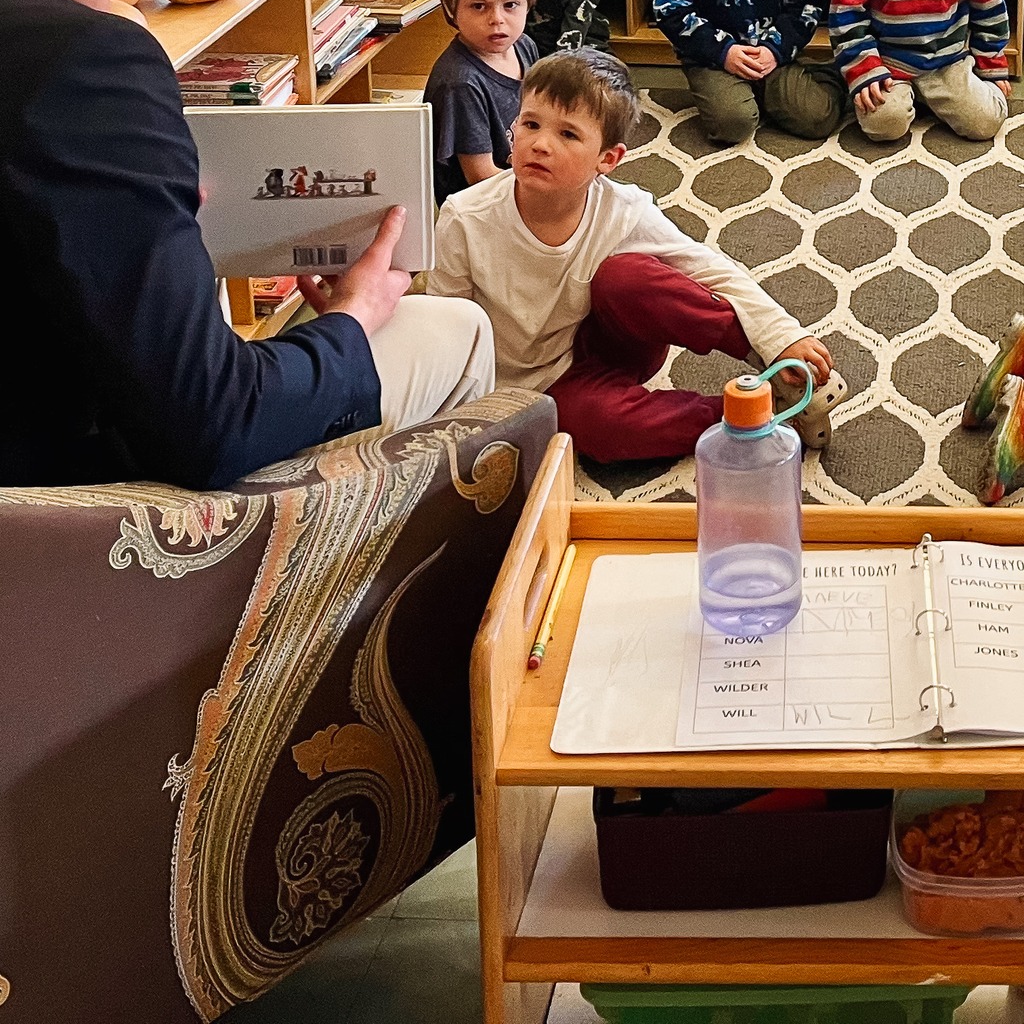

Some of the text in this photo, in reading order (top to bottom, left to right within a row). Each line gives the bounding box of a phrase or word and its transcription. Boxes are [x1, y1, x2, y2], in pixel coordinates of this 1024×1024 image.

[960, 553, 973, 566] IS
[815, 565, 845, 578] HERE
[850, 563, 898, 577] TODAY?
[969, 600, 1014, 612] FINLEY
[978, 623, 1010, 634] HAM
[724, 636, 764, 645] NOVA
[974, 646, 1019, 658] JONES
[724, 659, 762, 669] SHEA
[714, 683, 769, 692] WILDER
[722, 709, 757, 718] WILL
